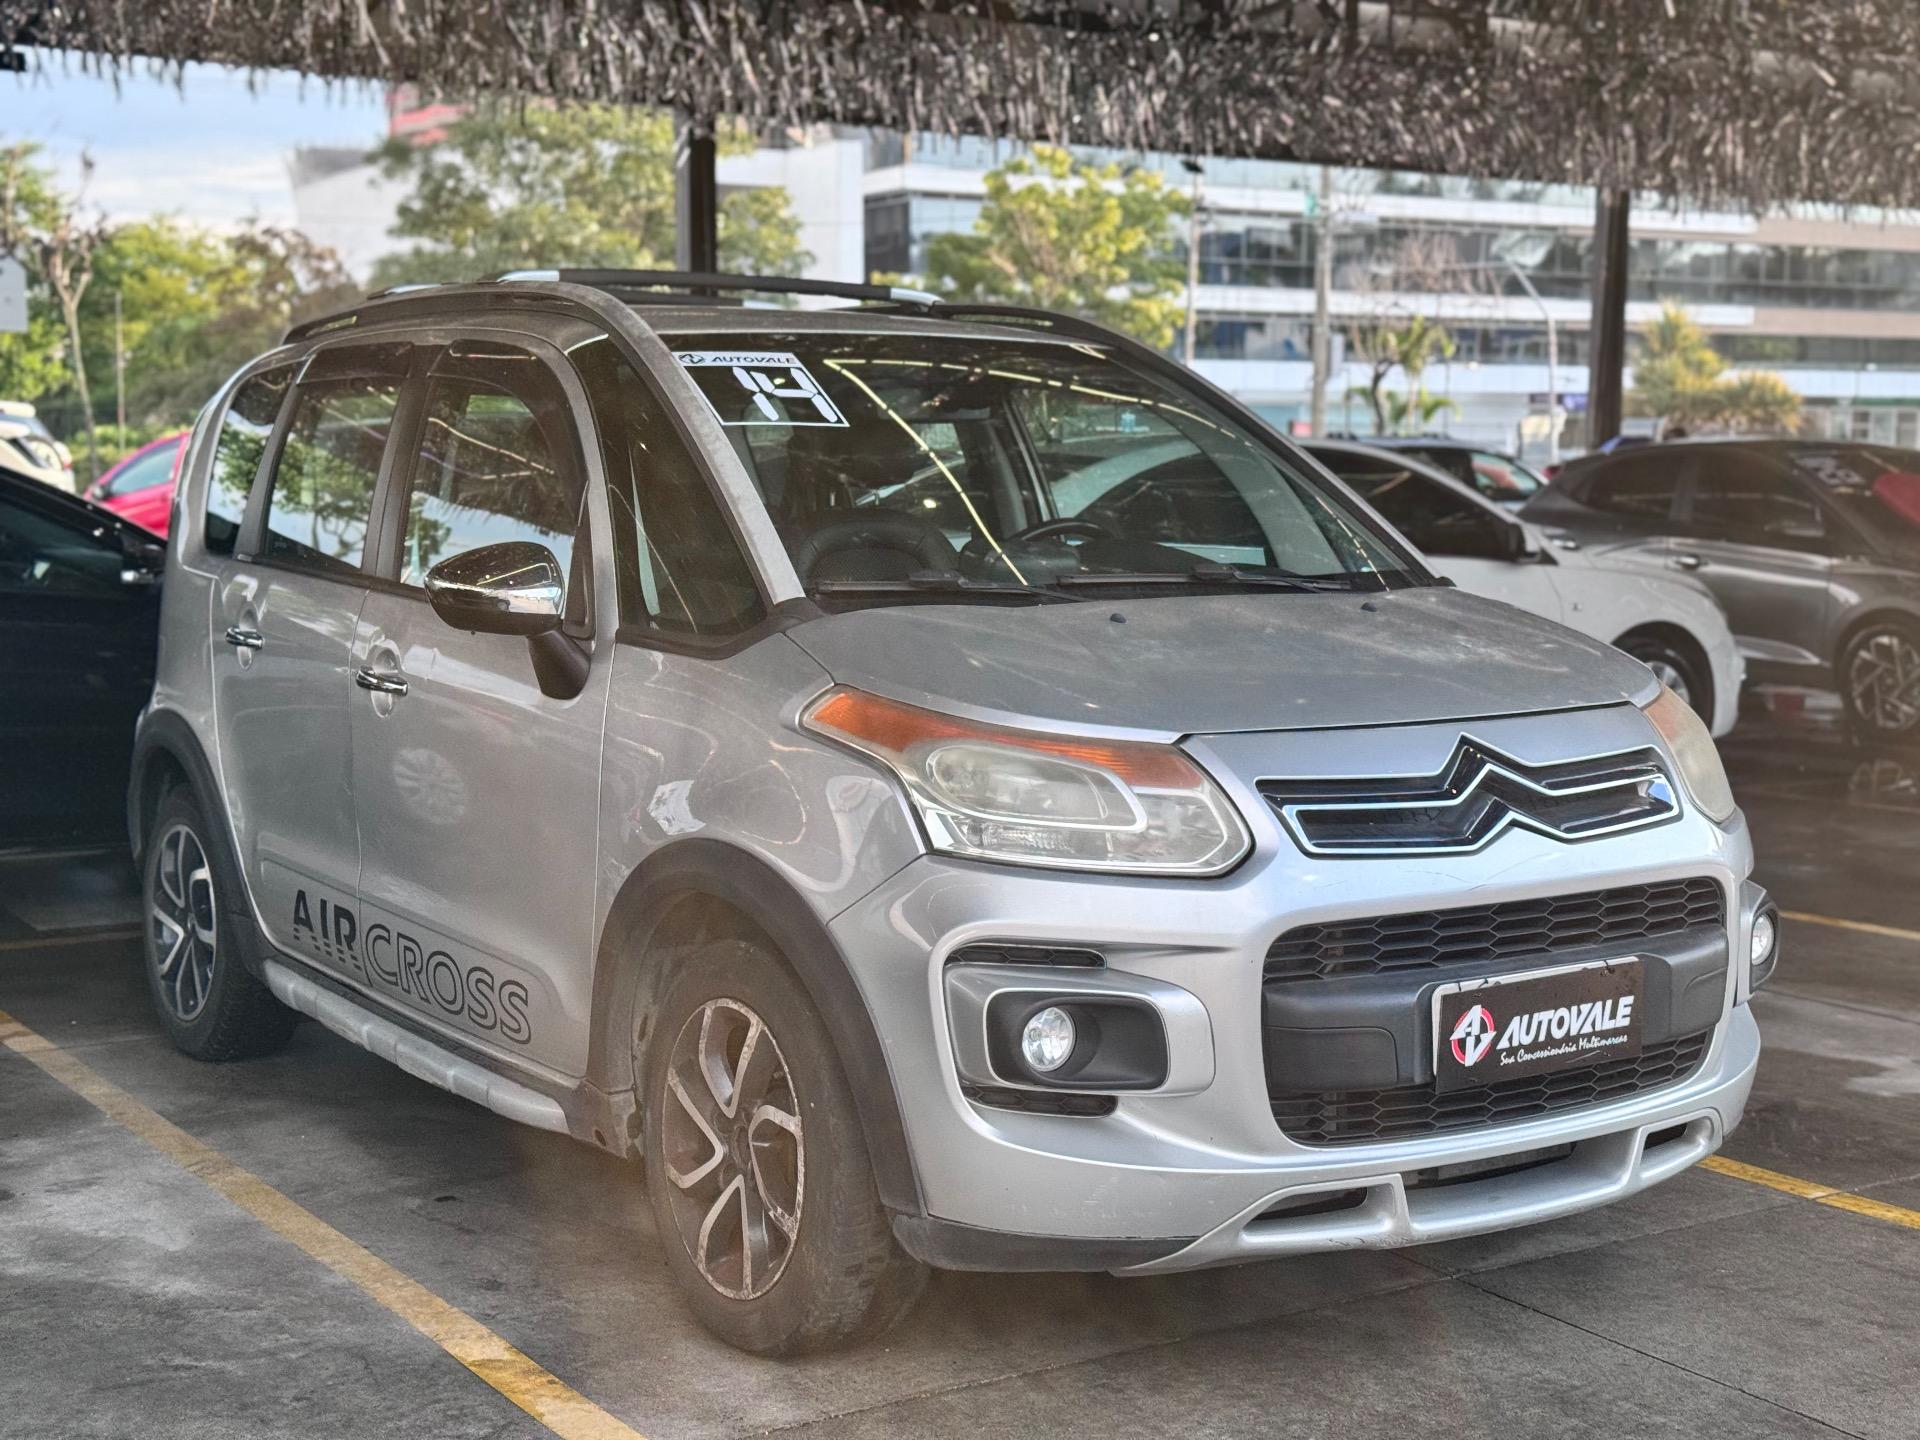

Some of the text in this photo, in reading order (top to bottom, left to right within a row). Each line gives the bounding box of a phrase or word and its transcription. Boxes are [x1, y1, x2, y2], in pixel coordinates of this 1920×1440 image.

[711, 356, 798, 365] AUTOVALE
[732, 366, 838, 423] 14
[293, 889, 531, 1044] AIRCROSS
[1496, 995, 1634, 1049] AUTOVALE
[1500, 1051, 1515, 1066] Sua
[1578, 1034, 1628, 1051] Multimarcas
